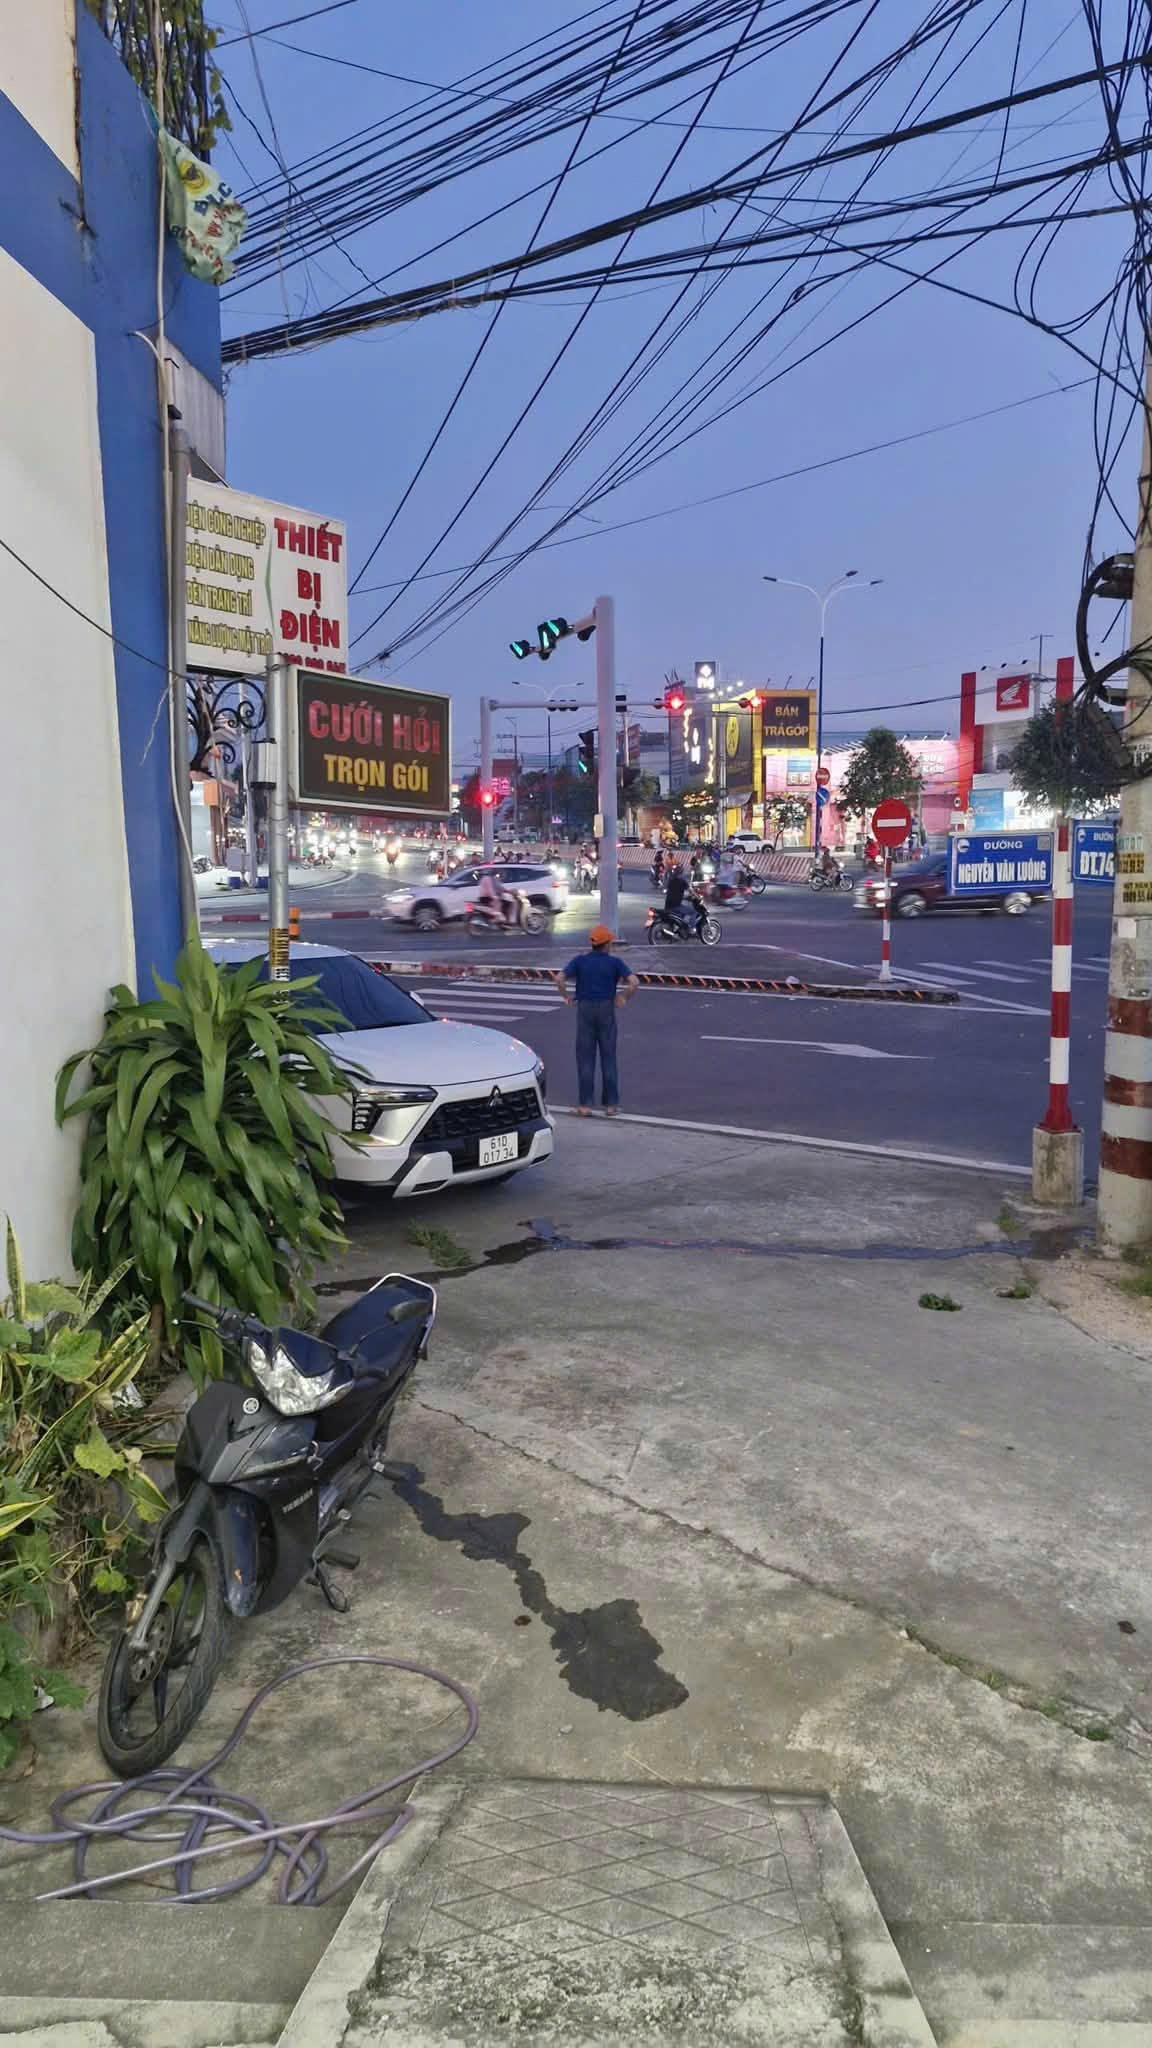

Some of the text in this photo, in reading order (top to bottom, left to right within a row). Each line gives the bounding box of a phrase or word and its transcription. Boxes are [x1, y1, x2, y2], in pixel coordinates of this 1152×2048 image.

[207, 505, 232, 537] CÔNG
[233, 516, 267, 549] NGHIỆP
[274, 517, 342, 563] THIẾT
[229, 552, 254, 582] DỤNG
[207, 585, 237, 613] TRANG
[237, 589, 253, 616] TRÍ
[297, 568, 321, 610] BỊ
[280, 609, 340, 652] ĐIỆN
[775, 704, 799, 717] BÁN
[309, 700, 441, 754] CƯỚI HỎI
[323, 753, 429, 792] TRỌN GÓI
[983, 840, 1023, 850] ĐƯỜNG
[1093, 831, 1114, 841] ĐƯỜN
[958, 857, 994, 884] NGUYỄN
[996, 859, 1015, 882] VĂN
[1080, 851, 1115, 877] ĐT.74
